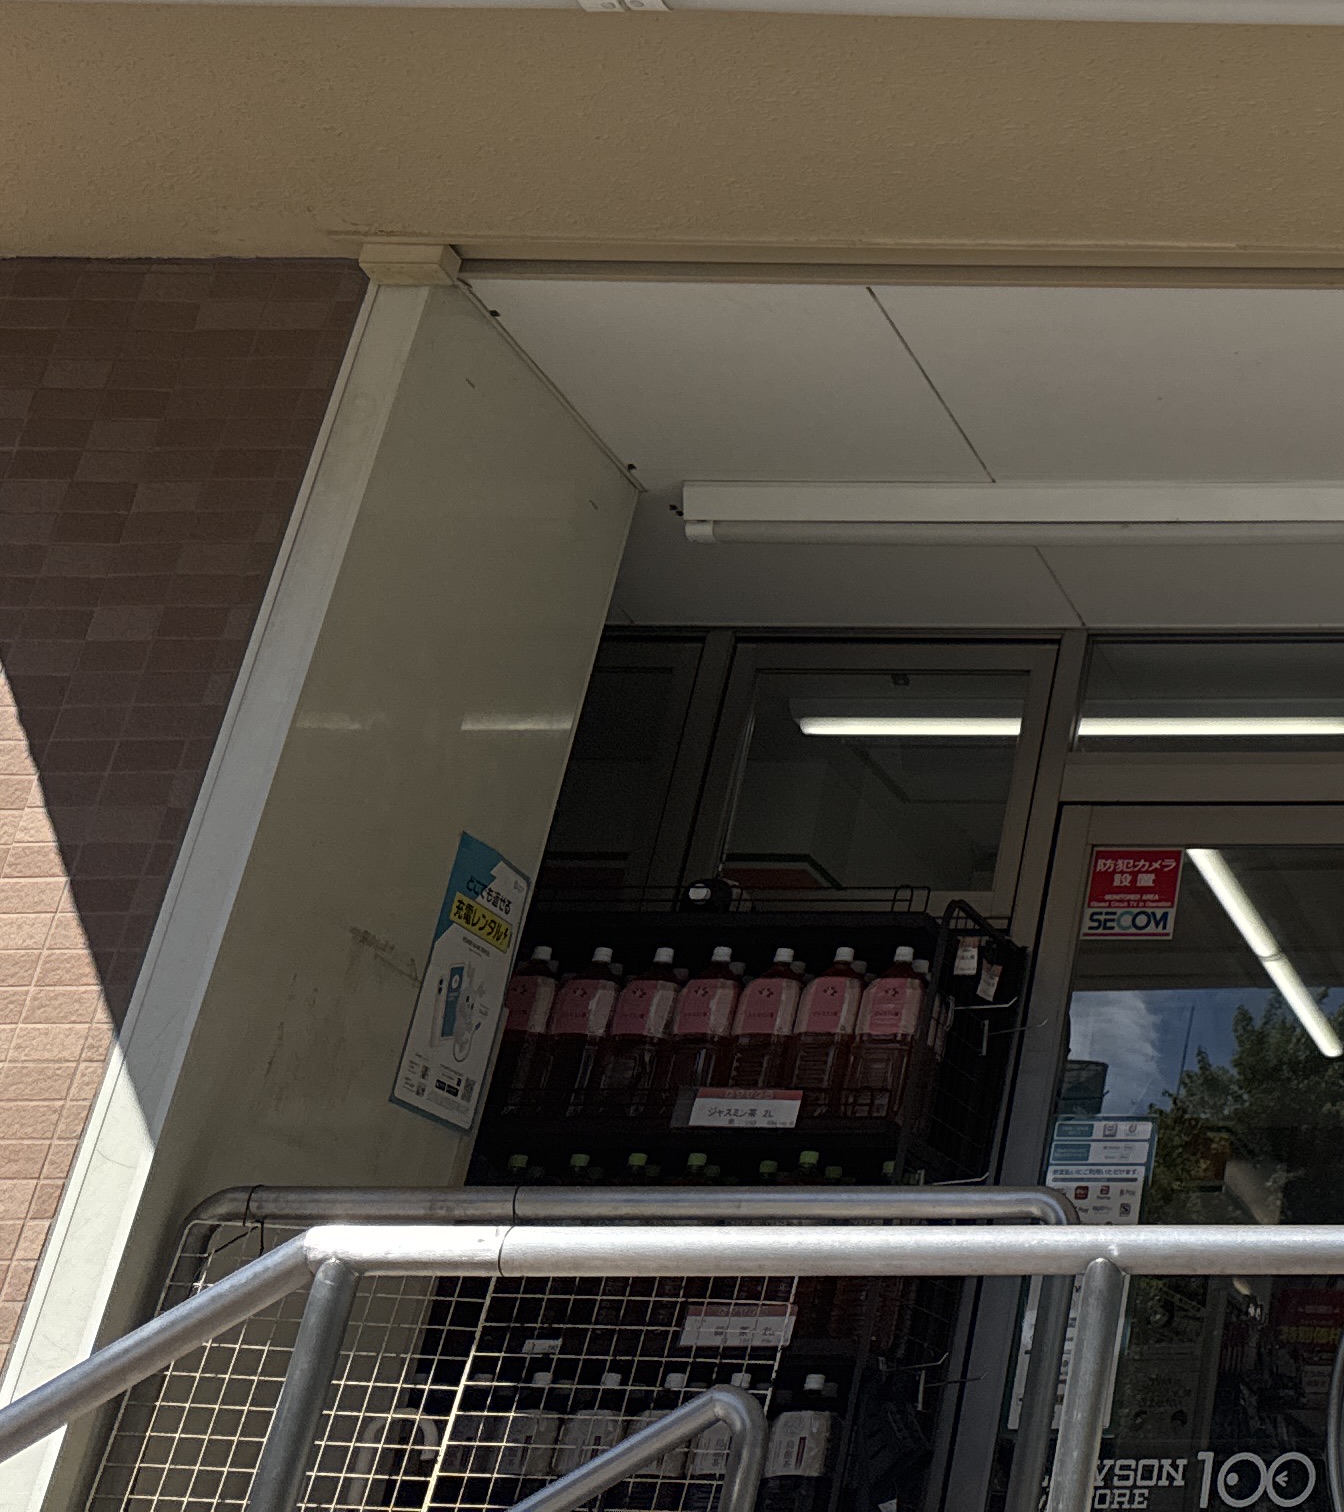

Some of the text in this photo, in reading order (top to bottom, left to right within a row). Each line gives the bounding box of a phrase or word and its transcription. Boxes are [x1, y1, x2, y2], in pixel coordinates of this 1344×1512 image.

[1096, 859, 1177, 872] 防犯カメラ
[1112, 873, 1156, 887] 設置
[1088, 910, 1169, 931] SECOM
[708, 1108, 757, 1117] ジャスミン茶
[1197, 1451, 1318, 1510] 100
